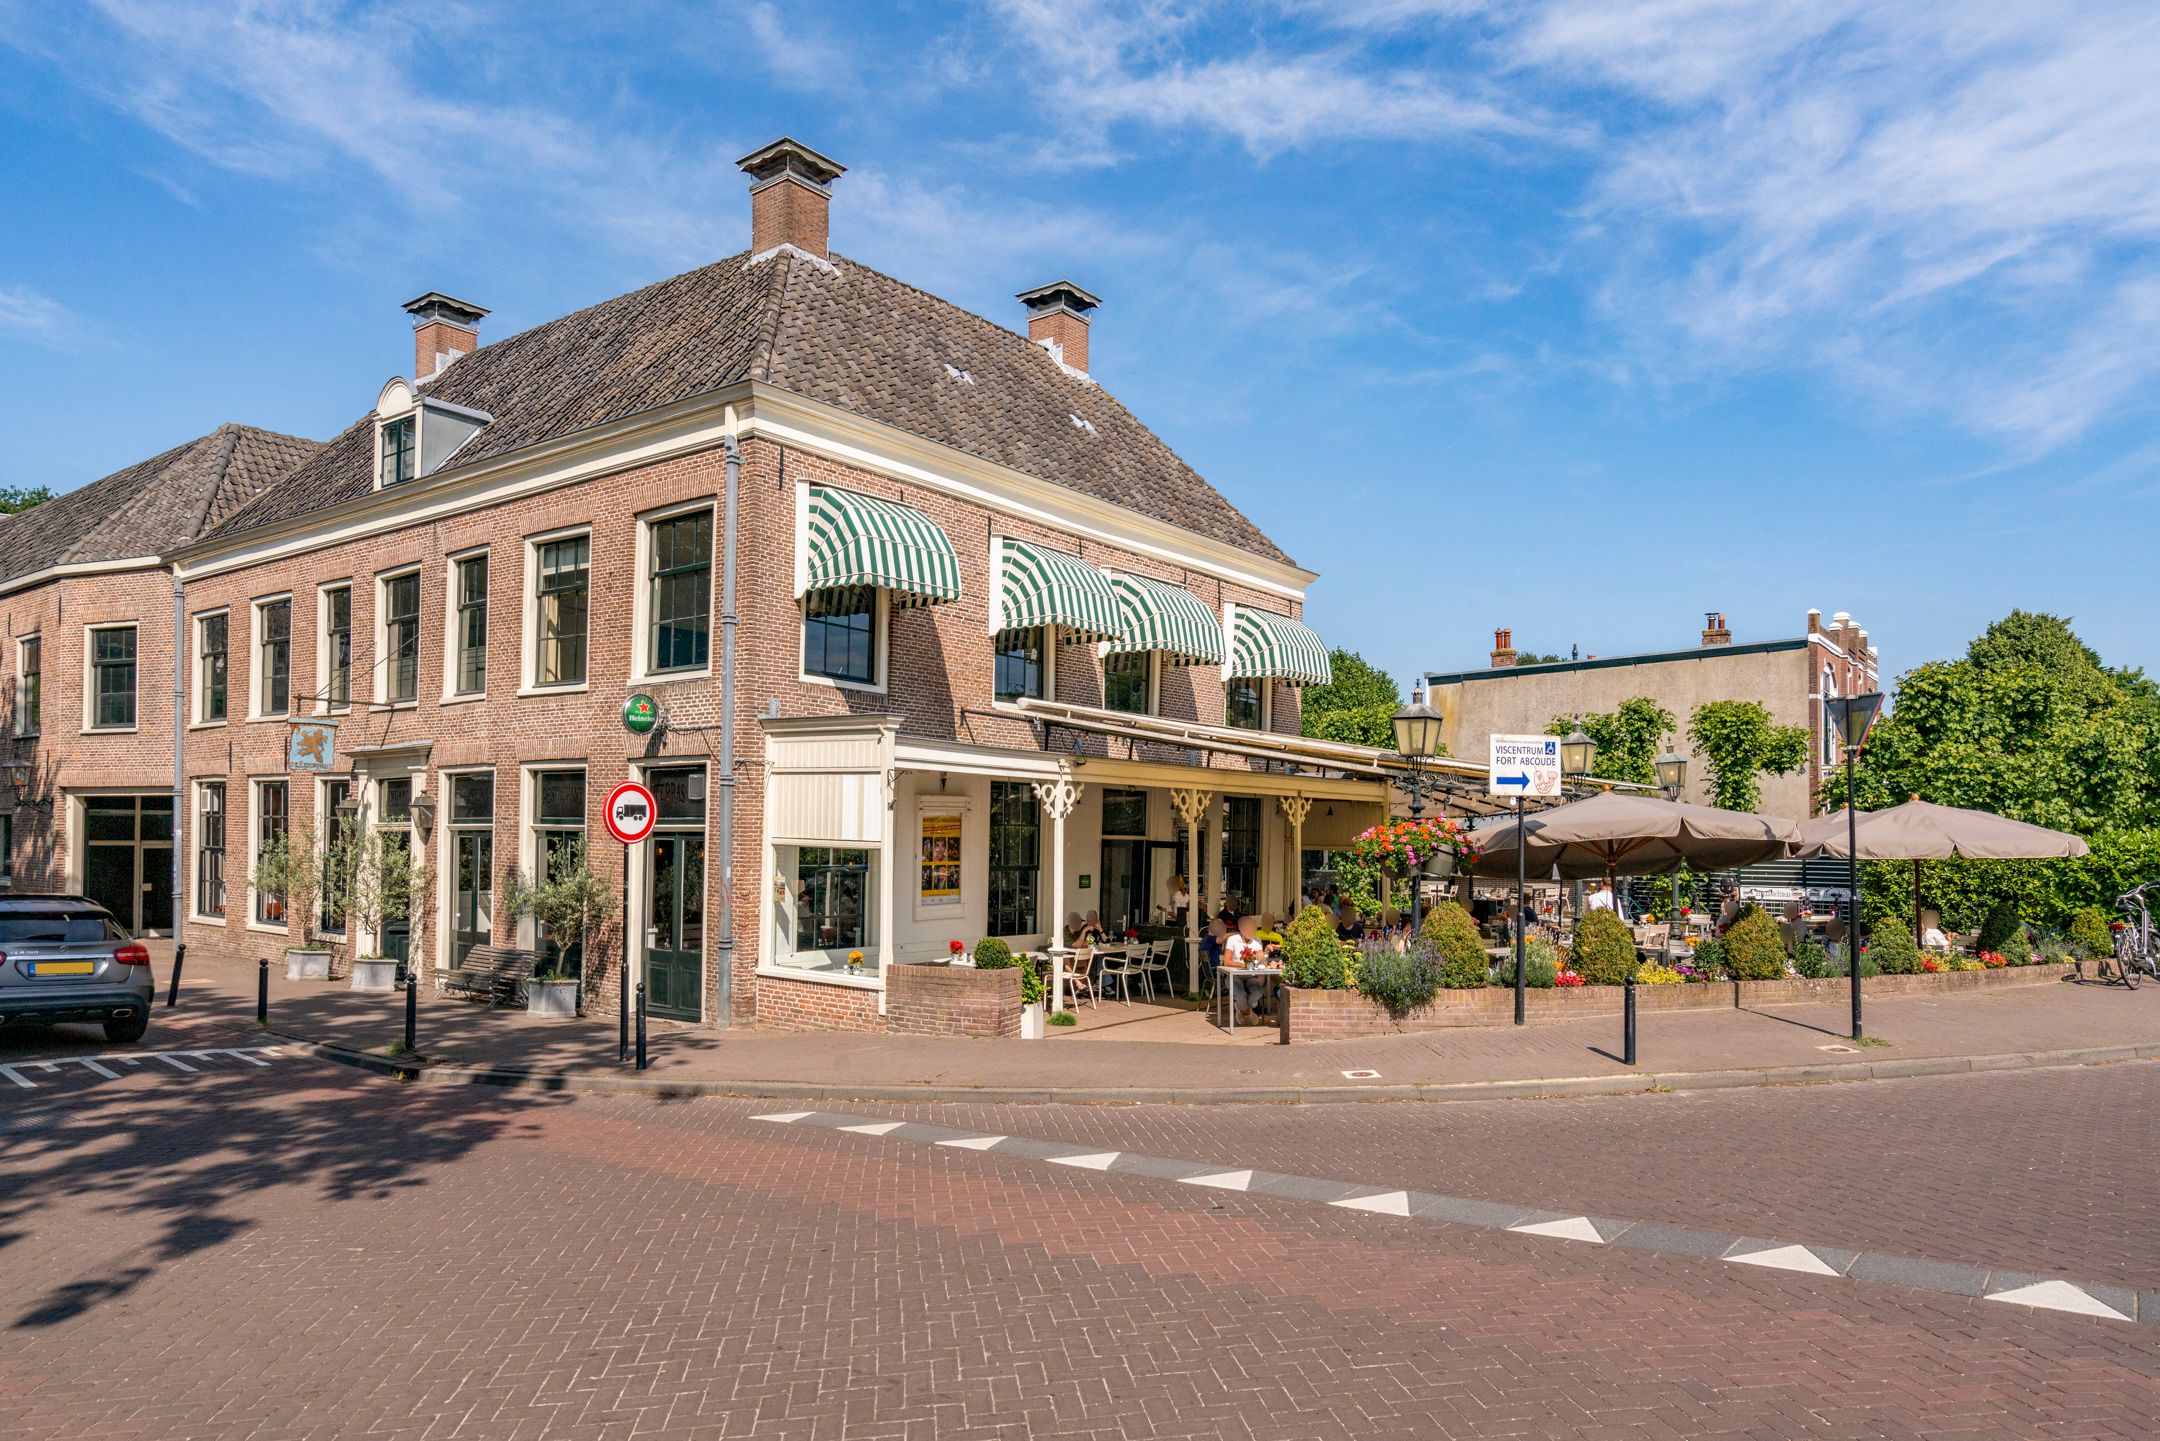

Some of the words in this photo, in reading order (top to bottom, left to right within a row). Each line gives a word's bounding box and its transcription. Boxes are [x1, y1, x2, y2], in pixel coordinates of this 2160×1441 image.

[1495, 745, 1544, 755] VISCENTRUM
[1496, 756, 1517, 765] FORT
[1519, 757, 1556, 766] ABCOUDE
